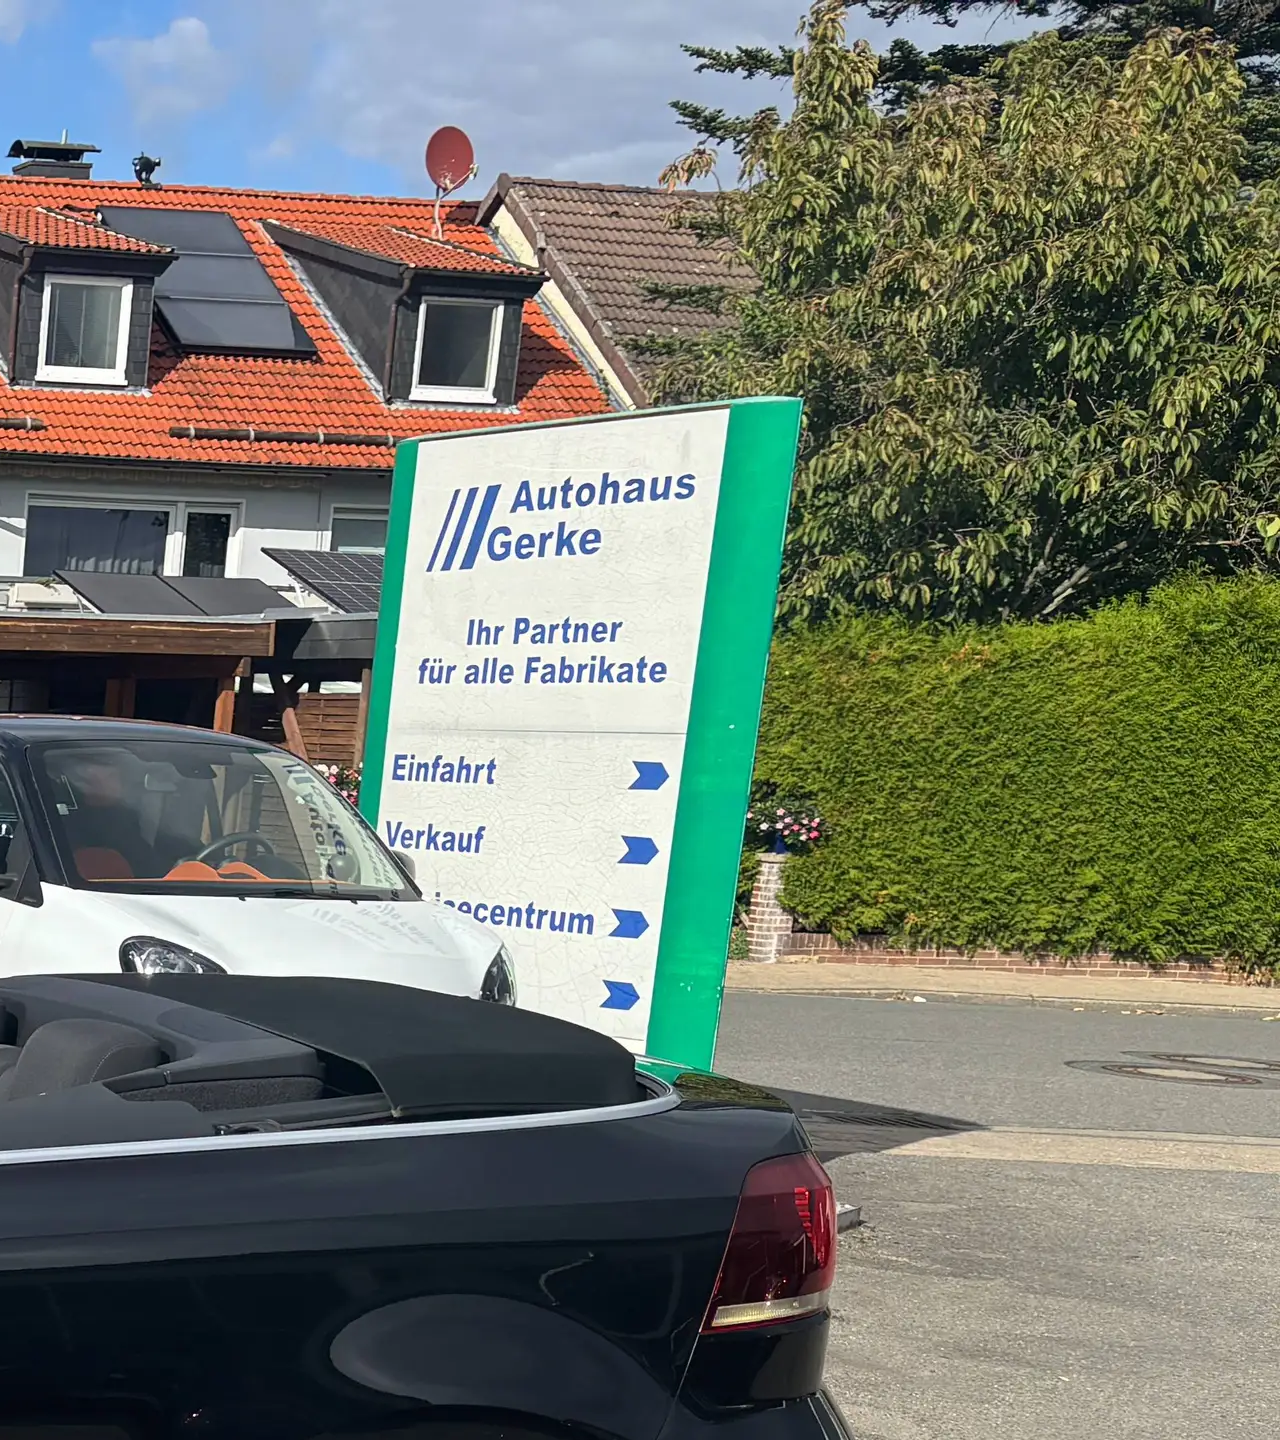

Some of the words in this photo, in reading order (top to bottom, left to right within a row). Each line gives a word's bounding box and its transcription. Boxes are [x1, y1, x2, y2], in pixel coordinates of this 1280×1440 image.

[510, 472, 696, 513] Autohaus
[486, 523, 602, 561] Gerke
[466, 618, 505, 646] Ihr
[512, 617, 623, 645] Partner
[418, 657, 456, 685] für
[463, 656, 515, 685] alle
[523, 655, 668, 685] Fabrikate
[391, 753, 497, 785] Einfahrt
[385, 820, 485, 854] Verkauf
[434, 891, 595, 935] ecentrum
